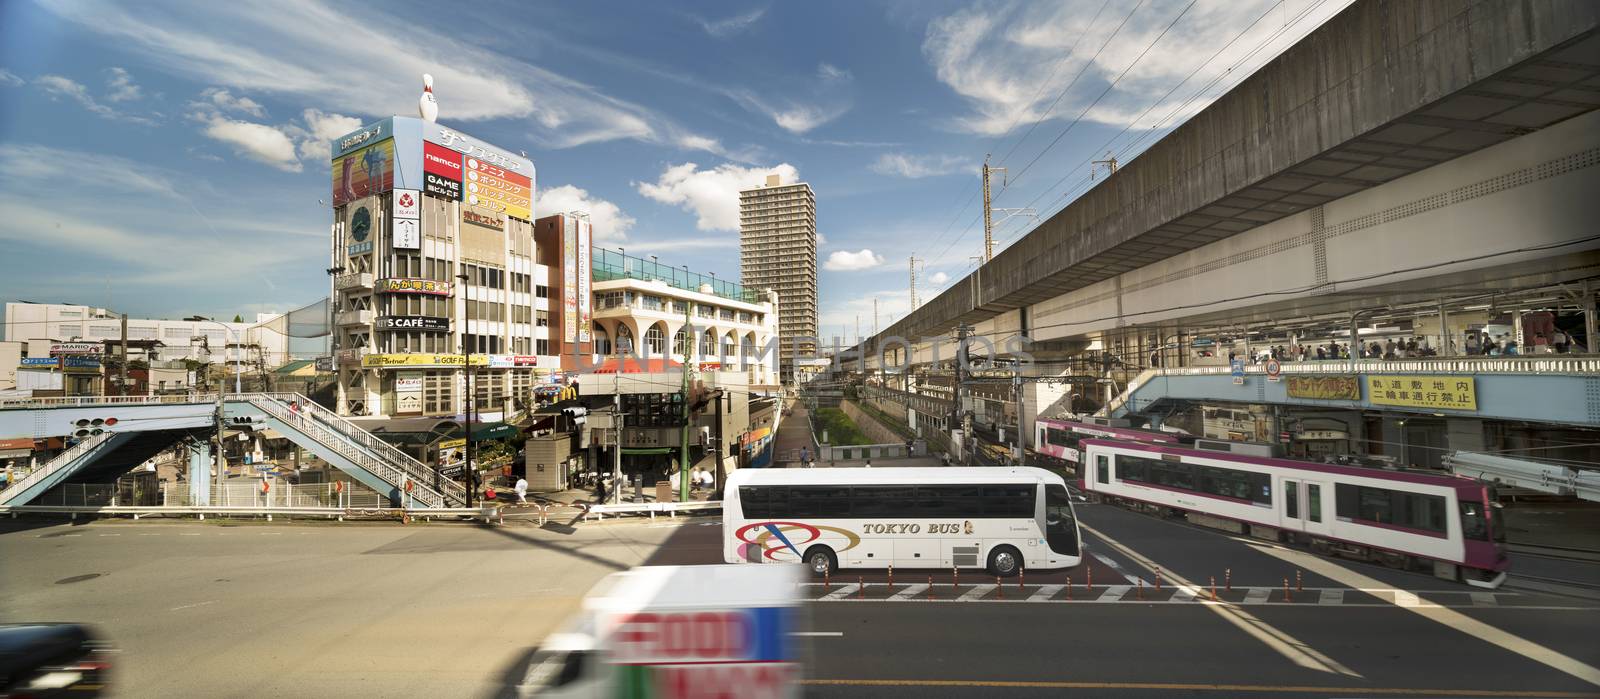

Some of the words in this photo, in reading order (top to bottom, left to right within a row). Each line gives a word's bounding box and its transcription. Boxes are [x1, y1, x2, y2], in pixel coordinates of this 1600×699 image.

[426, 153, 460, 169] namco
[480, 164, 505, 179] テニス
[427, 175, 459, 191] GAME
[480, 175, 521, 193] ボウリング
[480, 186, 528, 207] バッティング
[480, 200, 506, 213] ゴルフ
[395, 317, 424, 327] CAFÉ
[1268, 363, 1278, 373] 40
[1373, 380, 1469, 392] 軌道敷地内
[1373, 390, 1471, 404] 二輪車通行禁止
[863, 523, 920, 534] TOKYO
[927, 523, 960, 534] BUS
